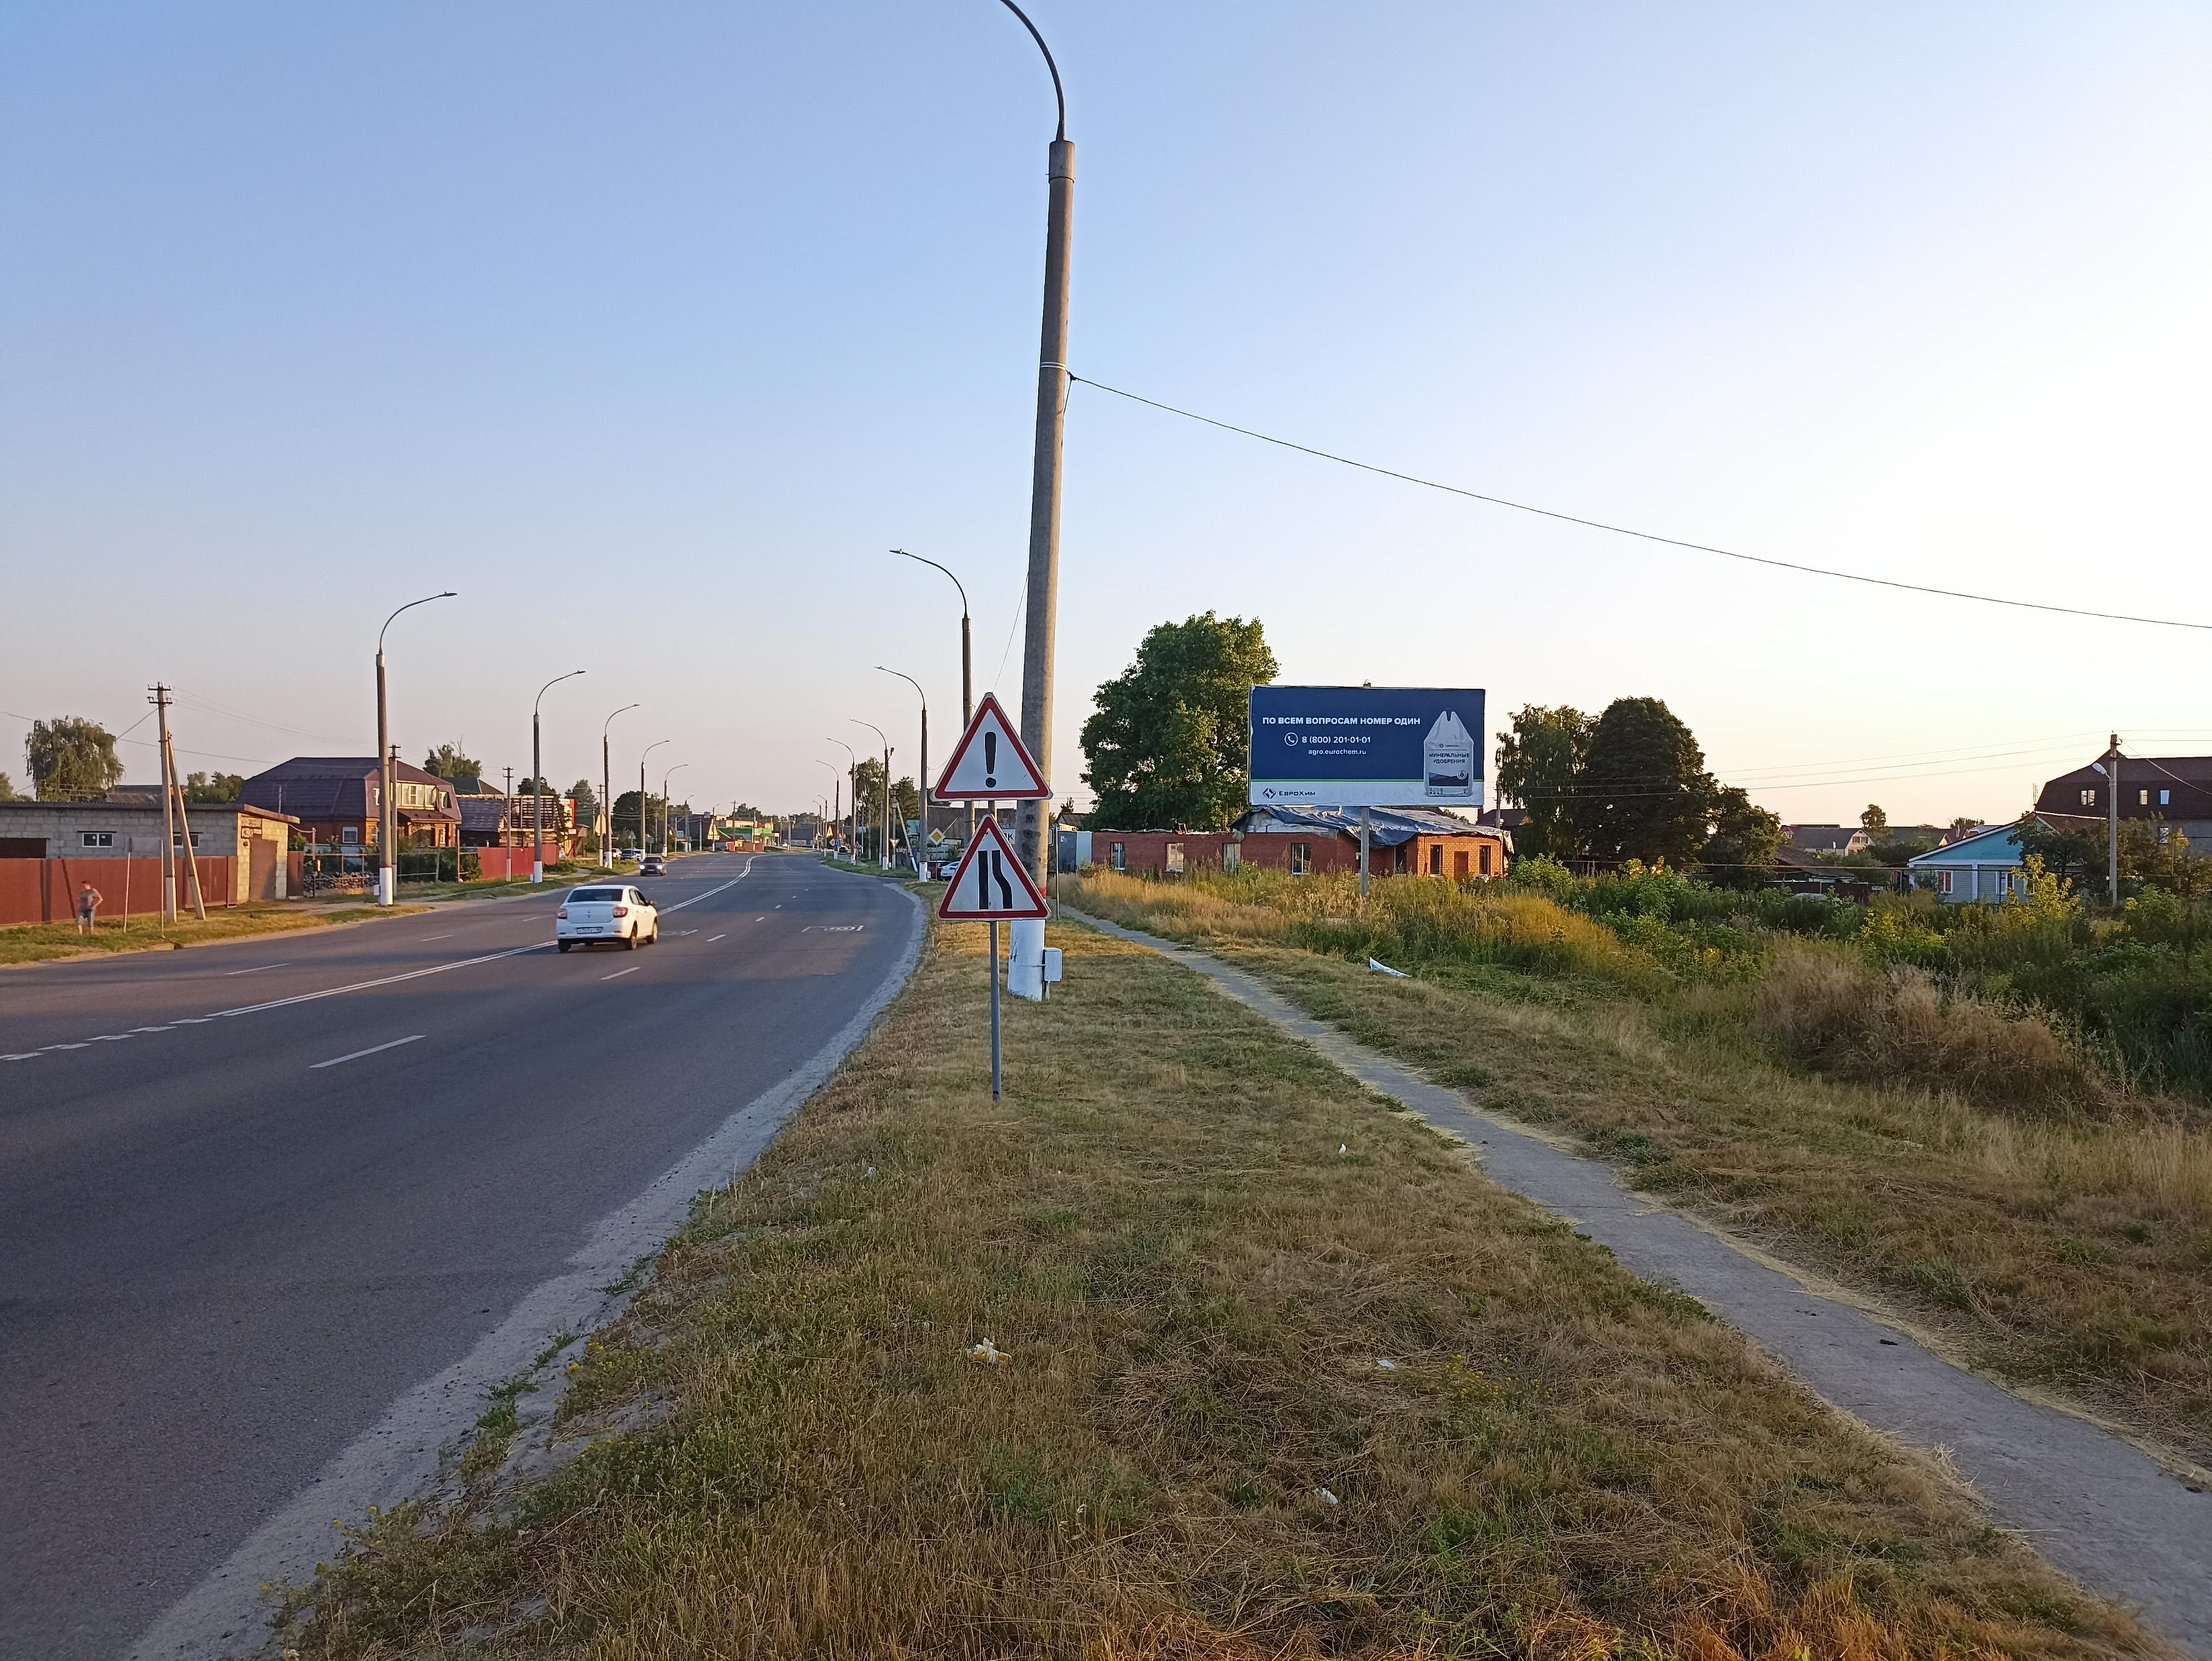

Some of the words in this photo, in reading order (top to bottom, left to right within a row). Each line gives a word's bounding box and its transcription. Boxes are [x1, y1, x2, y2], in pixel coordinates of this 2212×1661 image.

[1262, 717, 1276, 725] ПО
[1278, 717, 1304, 725] ВСЕМ
[1306, 717, 1358, 725] ВОПРОСАМ
[1360, 717, 1392, 725] НОМЕР
[1394, 717, 1421, 726] ОДИН
[1301, 736, 1308, 744] 8
[1309, 736, 1331, 744] (800)
[1333, 736, 1371, 744] 201-01-01
[1308, 748, 1367, 756] agro.eurochem.ru
